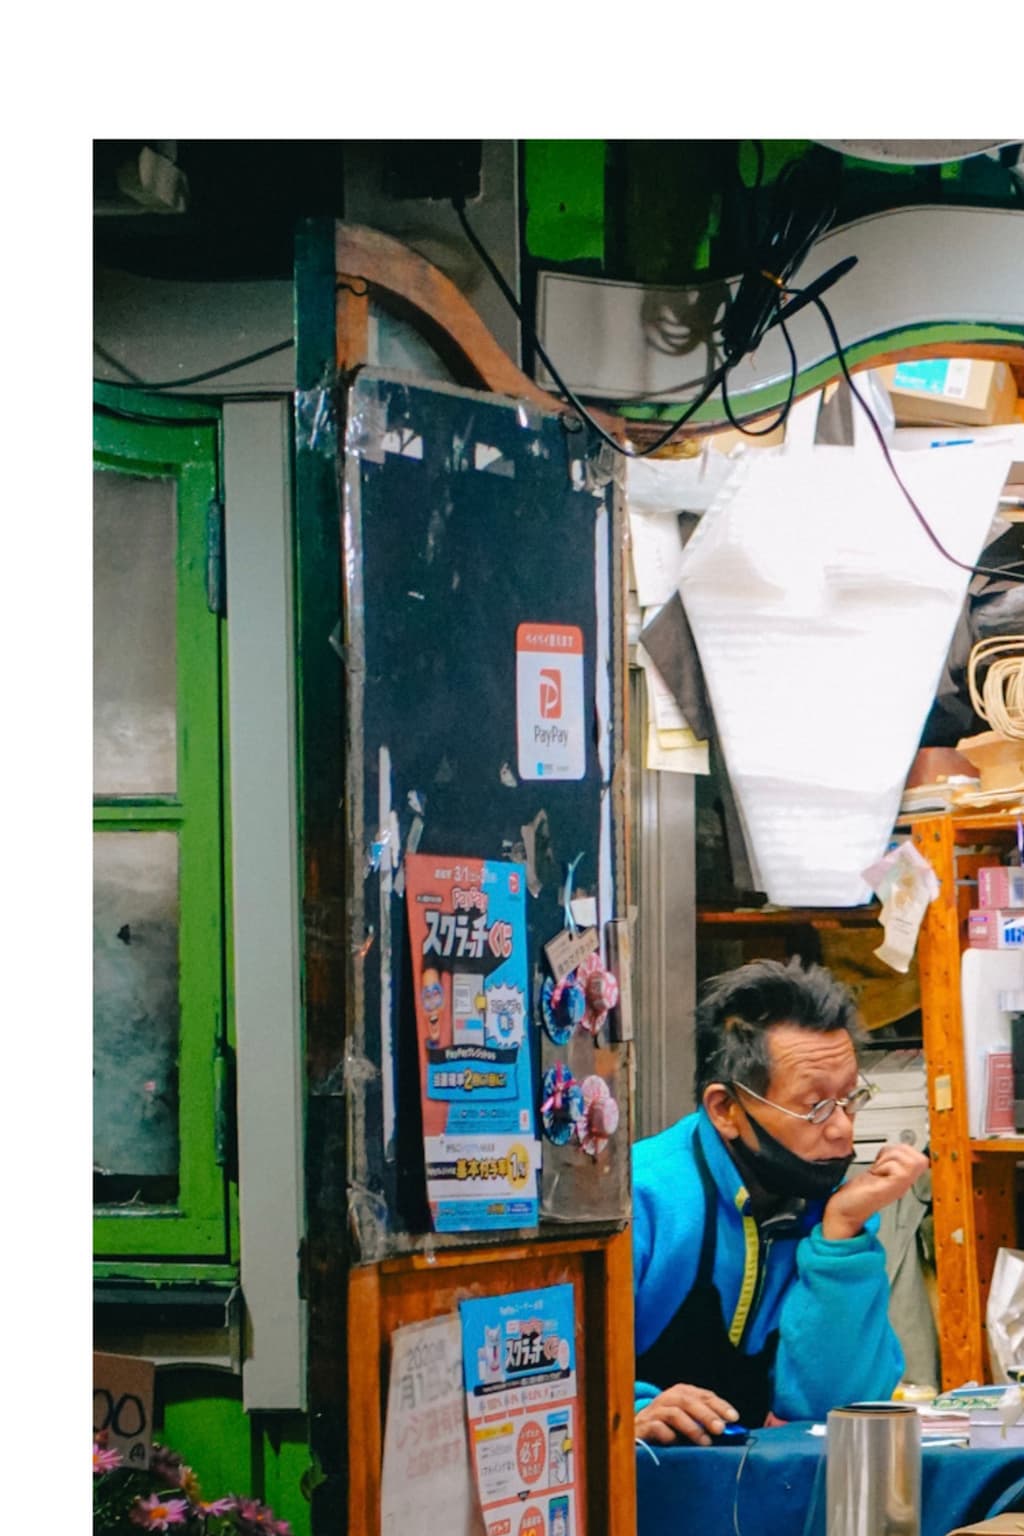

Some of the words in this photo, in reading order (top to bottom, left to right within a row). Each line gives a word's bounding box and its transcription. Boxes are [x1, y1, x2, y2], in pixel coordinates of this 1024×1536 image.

[534, 724, 568, 748] PayPay
[423, 911, 513, 959] スクラッチくじ
